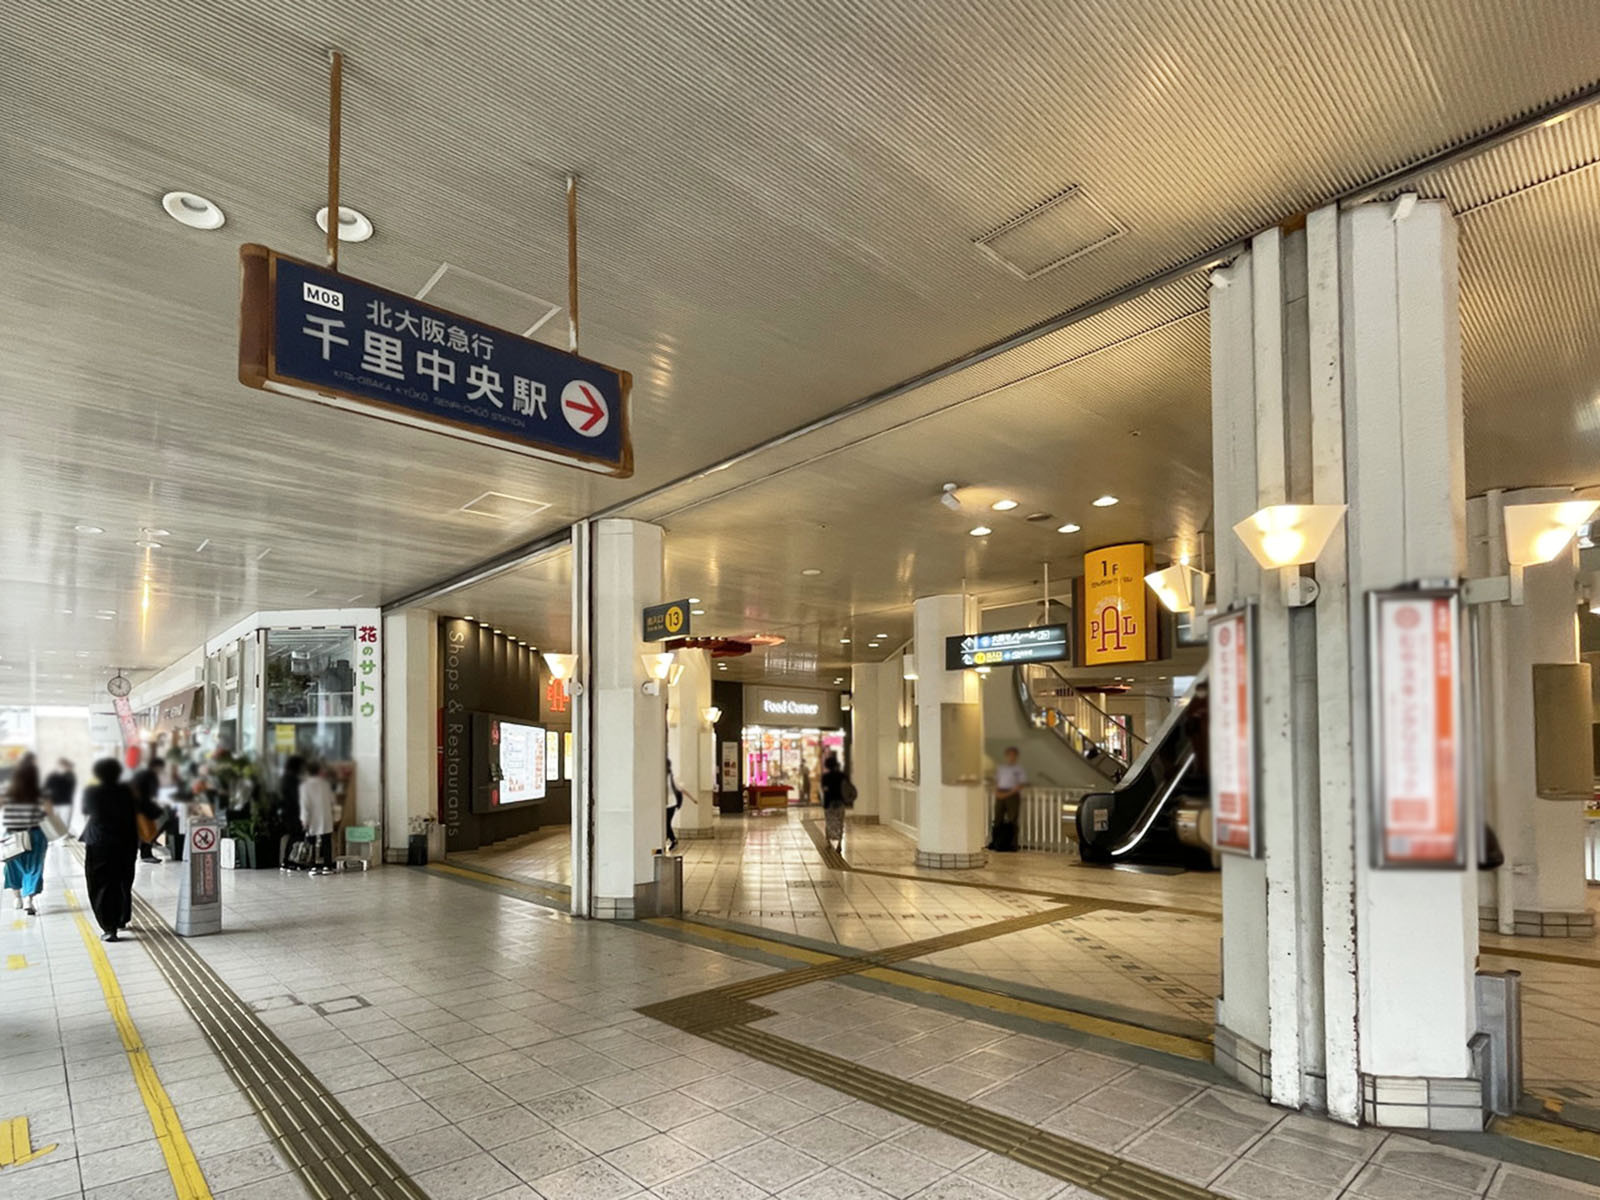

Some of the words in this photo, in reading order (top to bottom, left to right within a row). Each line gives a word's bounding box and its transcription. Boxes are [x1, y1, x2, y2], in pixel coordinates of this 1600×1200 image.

[306, 286, 341, 307] M08
[366, 300, 495, 360] 北大阪急行
[302, 314, 548, 421] 千里中央駅
[668, 611, 680, 627] 13
[1090, 605, 1137, 653] PAL
[358, 625, 377, 718] 花のサトウ
[446, 631, 465, 691] Shops
[447, 699, 464, 715] &
[763, 699, 787, 713] Food
[788, 701, 819, 715] Corner
[447, 723, 464, 838] Restaurants
